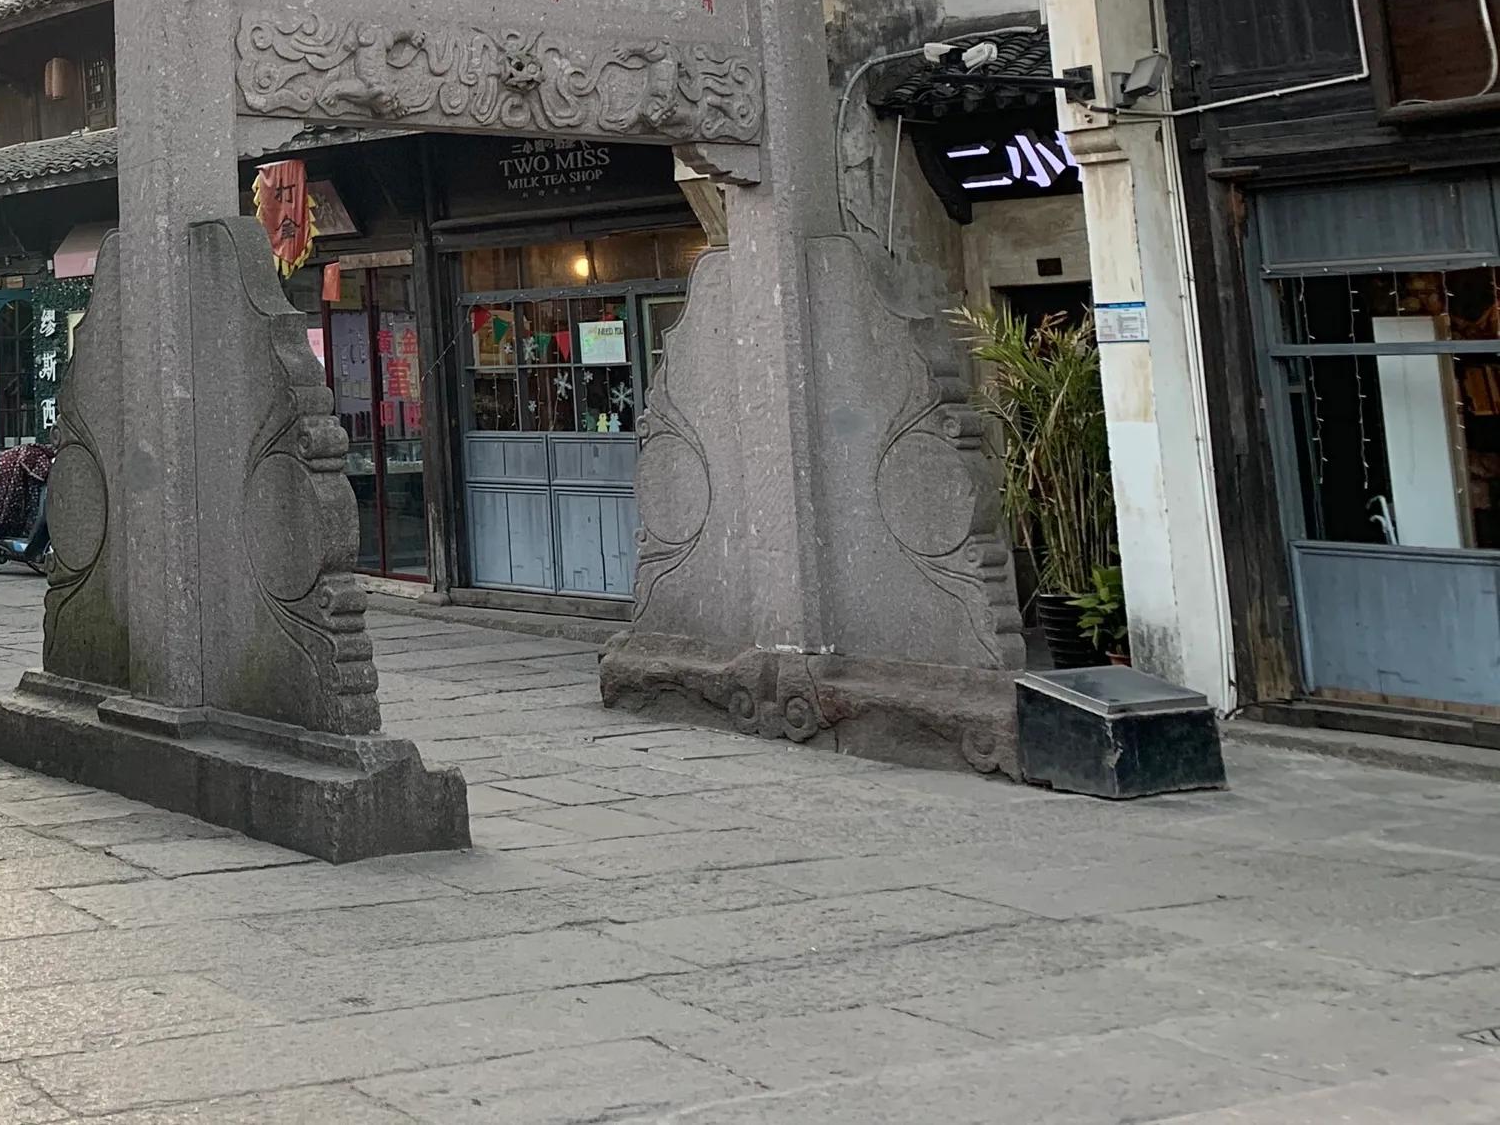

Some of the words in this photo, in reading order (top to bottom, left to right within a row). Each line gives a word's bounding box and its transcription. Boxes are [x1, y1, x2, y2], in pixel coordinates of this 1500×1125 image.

[499, 155, 550, 177] TWO
[555, 147, 610, 170] MISS
[508, 177, 539, 189] MILK
[543, 174, 567, 185] TEA
[569, 169, 602, 183] SHOP
[274, 178, 300, 239] 打金
